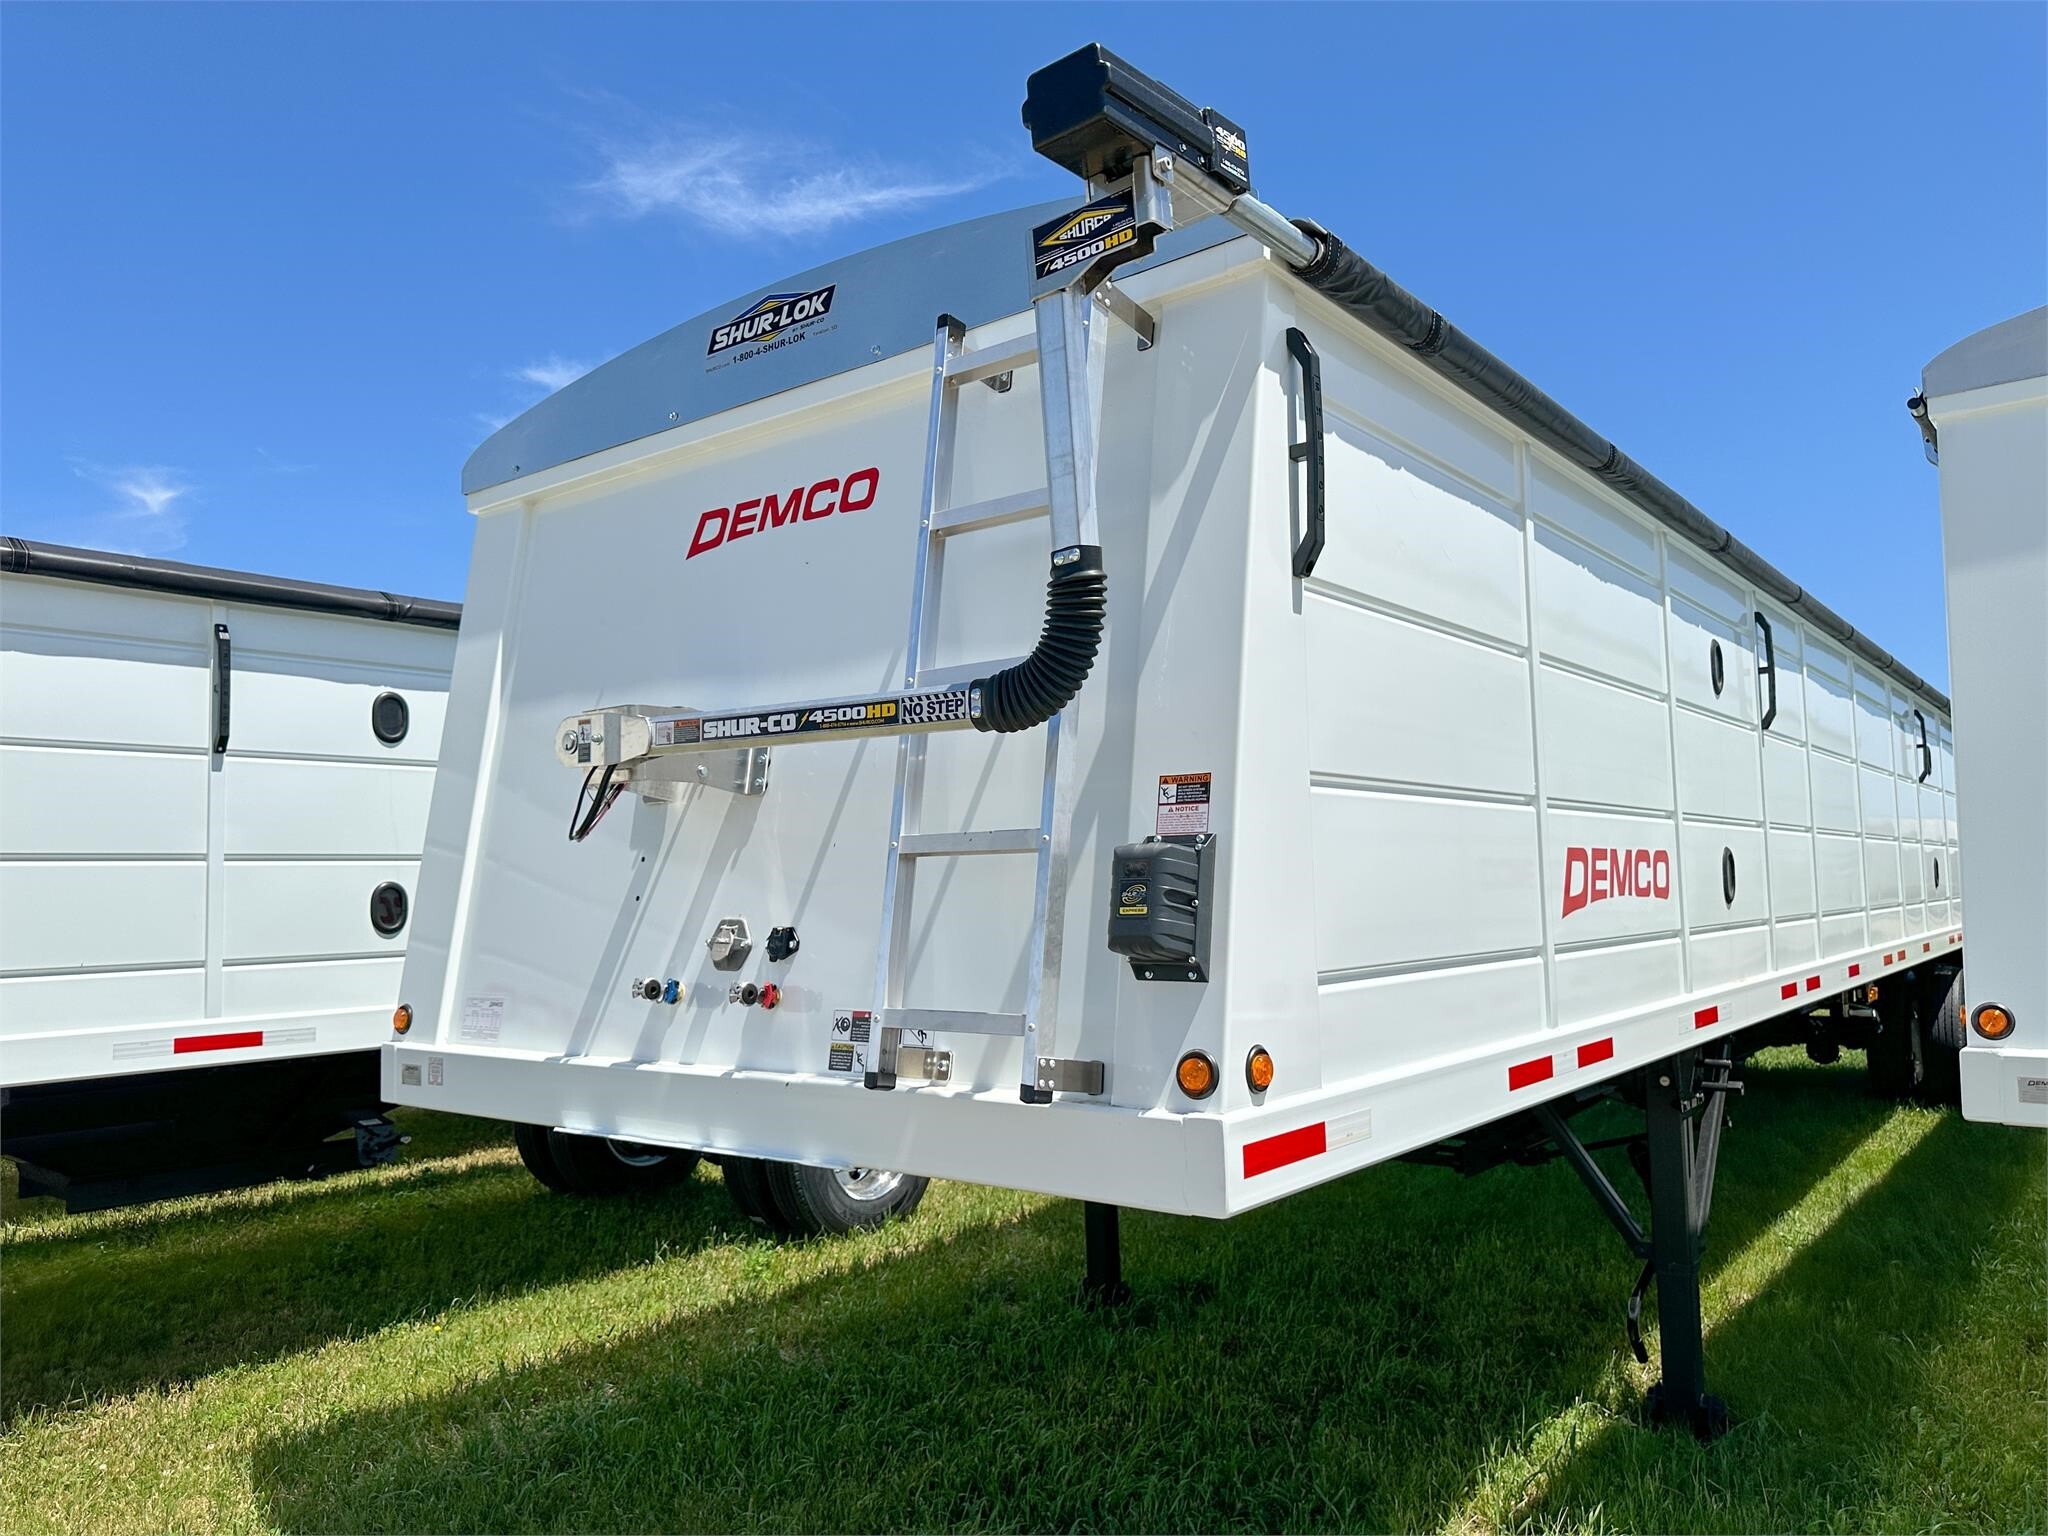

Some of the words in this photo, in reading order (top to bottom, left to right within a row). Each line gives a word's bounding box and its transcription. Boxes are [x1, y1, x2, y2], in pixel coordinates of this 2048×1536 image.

[1049, 228, 1133, 271] 4500HD
[712, 291, 829, 351] SHUR-LOK
[733, 331, 806, 364] 1-800-4-SHUR-LOK
[685, 467, 880, 560] DEMCO
[703, 713, 796, 738] SHUR-CO
[808, 703, 896, 723] 4500HD
[902, 702, 924, 717] NO
[926, 698, 964, 715] STEP
[1171, 774, 1209, 783] WARNING
[1174, 805, 1199, 813] NOTICE
[1561, 847, 1670, 919] DEMCO
